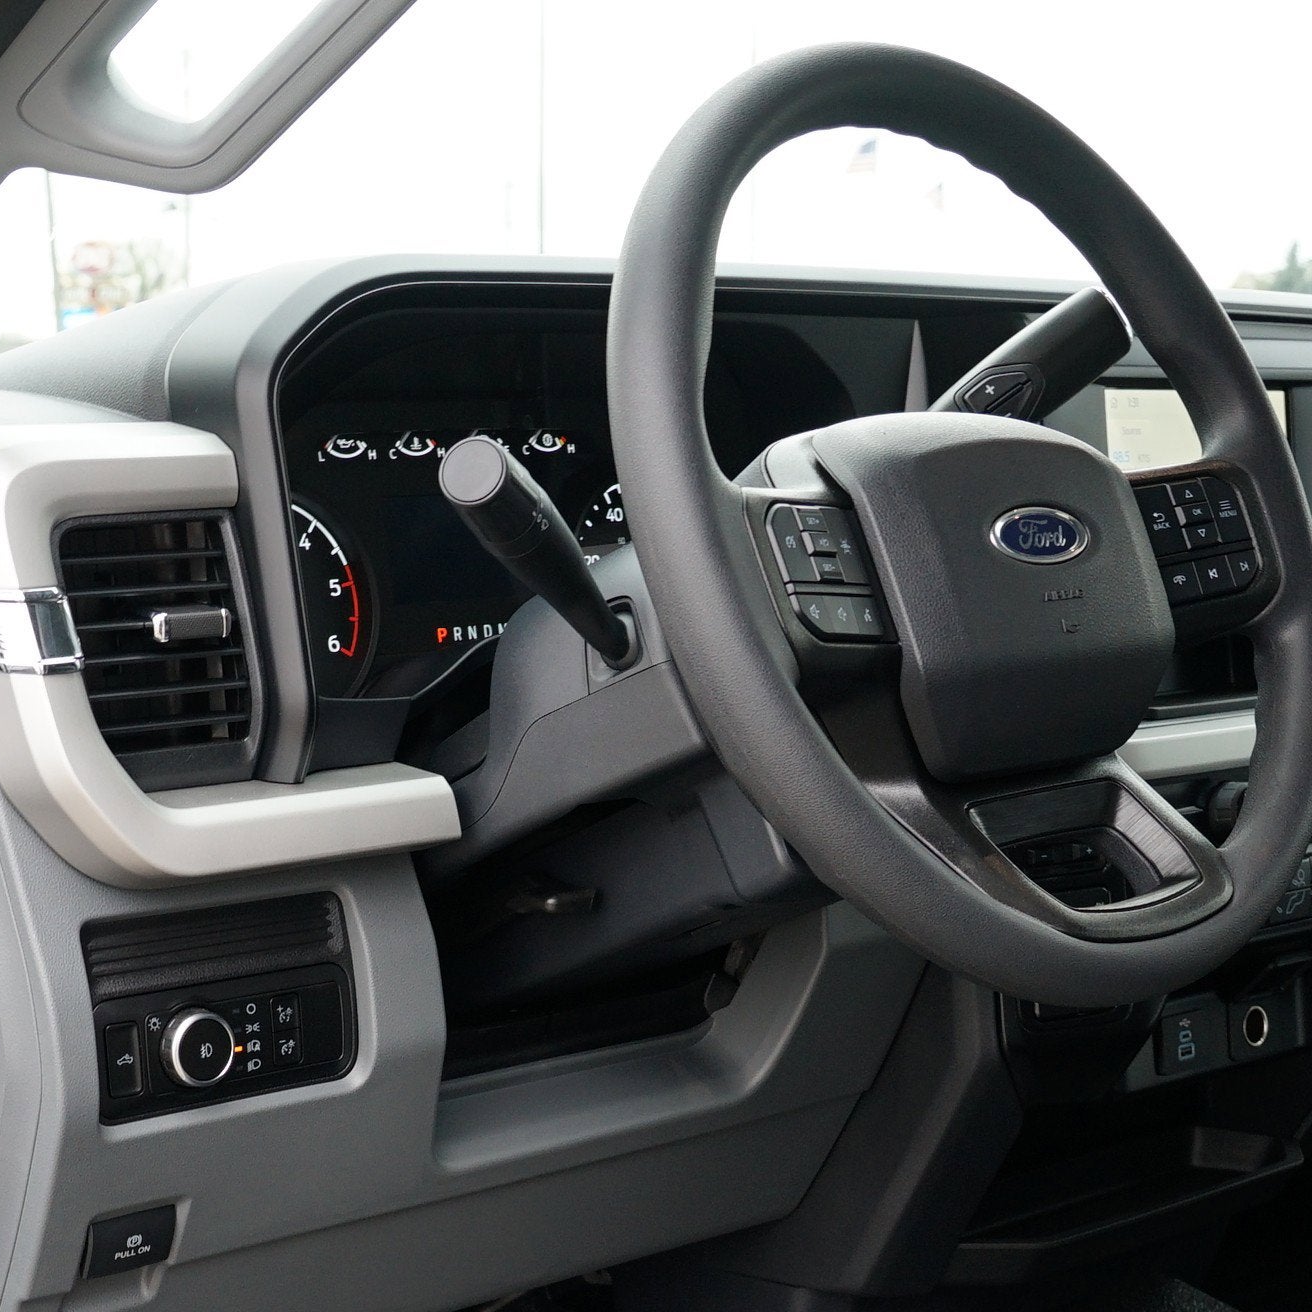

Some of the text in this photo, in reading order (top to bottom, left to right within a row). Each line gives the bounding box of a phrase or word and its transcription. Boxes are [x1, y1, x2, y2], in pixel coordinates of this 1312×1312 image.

[368, 449, 377, 460] H
[389, 448, 397, 459] C
[522, 444, 575, 455] C H
[606, 507, 624, 522] 40
[1192, 508, 1203, 516] OK
[1219, 509, 1238, 518] MENU
[1018, 518, 1067, 550] Ford
[1152, 522, 1172, 531] BACK
[299, 532, 311, 550] 4
[329, 579, 342, 597] 5
[437, 627, 448, 643] P
[453, 626, 463, 642] R
[468, 625, 478, 640] N
[483, 624, 493, 638] D
[328, 635, 341, 652] 6
[114, 1244, 151, 1260] PULL ON
